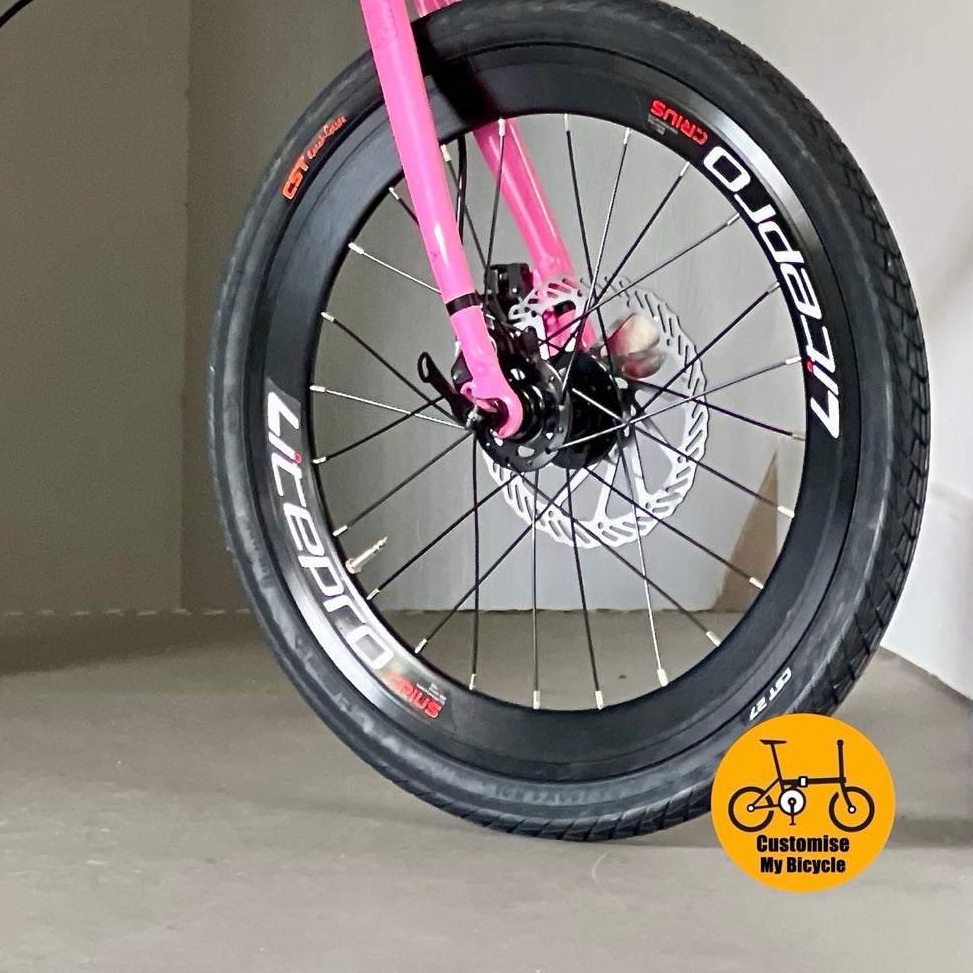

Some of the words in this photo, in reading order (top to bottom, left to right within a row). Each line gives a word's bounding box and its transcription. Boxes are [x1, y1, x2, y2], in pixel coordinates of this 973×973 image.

[650, 99, 709, 145] CRIUS
[282, 155, 309, 200] CST
[382, 671, 442, 719] CRIUS
[768, 667, 792, 702] CST
[749, 696, 768, 721] 27
